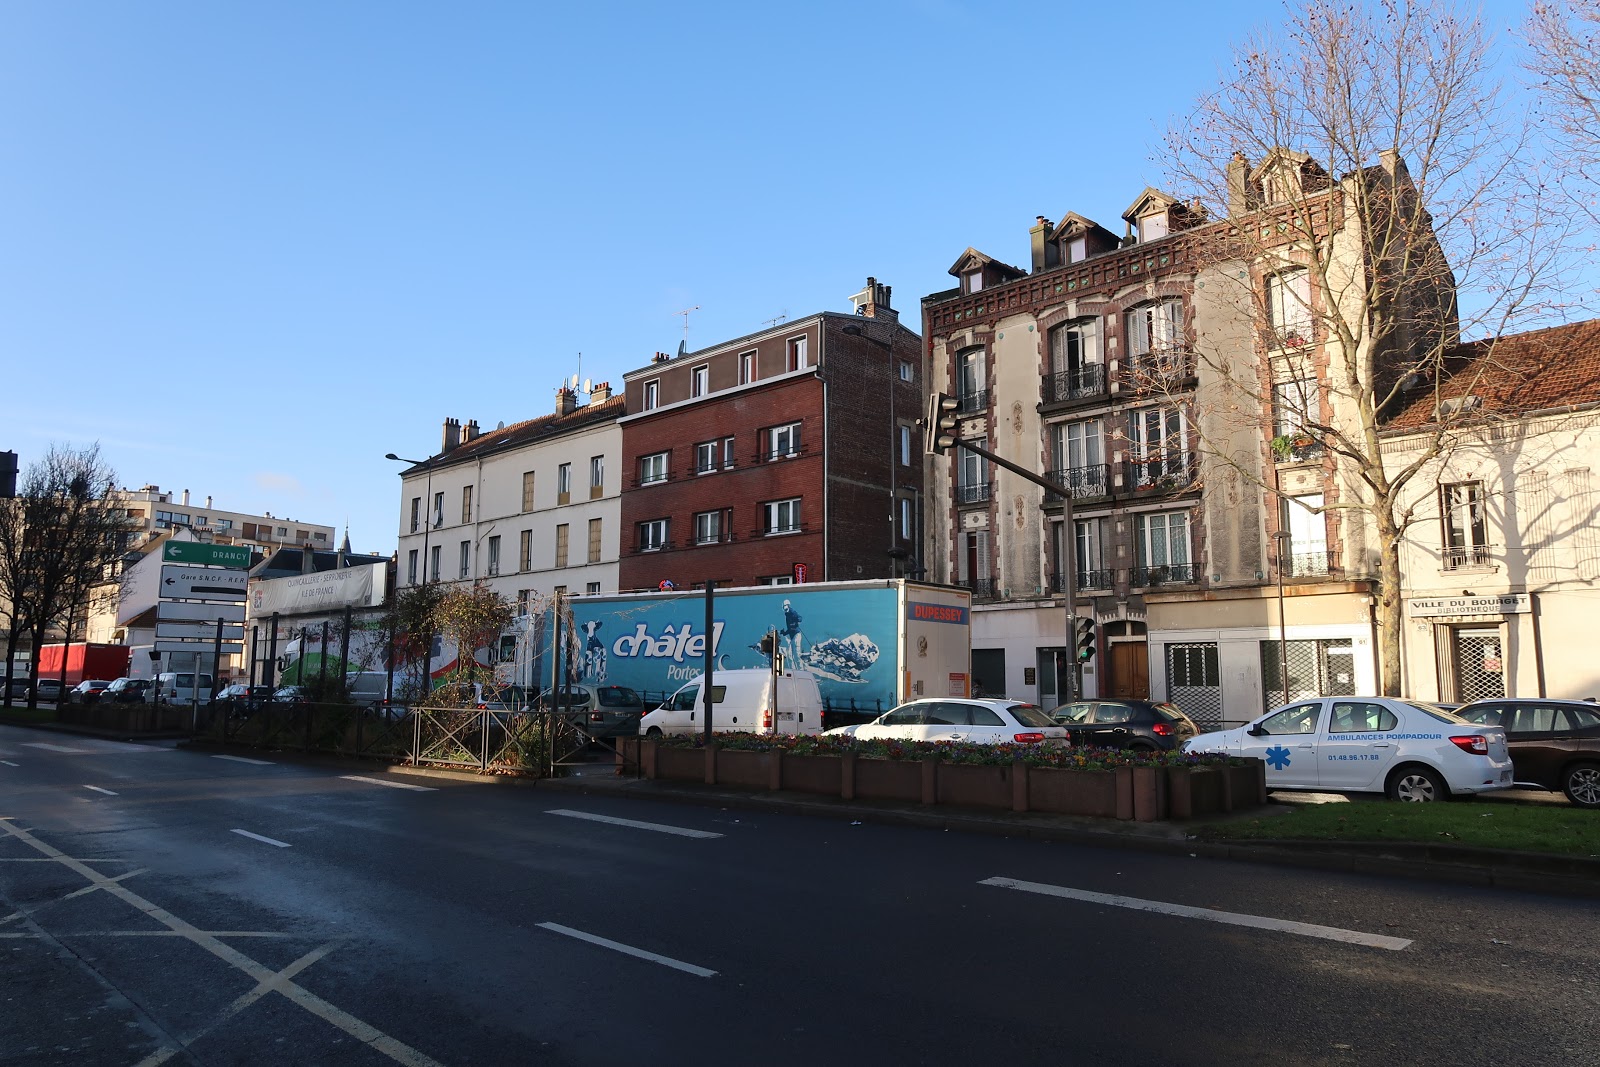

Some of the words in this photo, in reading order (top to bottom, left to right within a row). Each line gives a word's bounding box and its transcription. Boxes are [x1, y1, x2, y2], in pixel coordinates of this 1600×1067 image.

[212, 550, 247, 560] DRANCY
[287, 576, 320, 588] QUINCAILLERIE
[308, 588, 315, 597] DE
[315, 586, 334, 596] FRANCE
[1412, 601, 1445, 609] VILLE
[1471, 597, 1527, 606] BOURGET
[915, 604, 963, 622] DUPESSEY
[1437, 605, 1501, 614] BIBLIOTHEQUE
[612, 621, 725, 663] châtel
[667, 664, 701, 680] Portes
